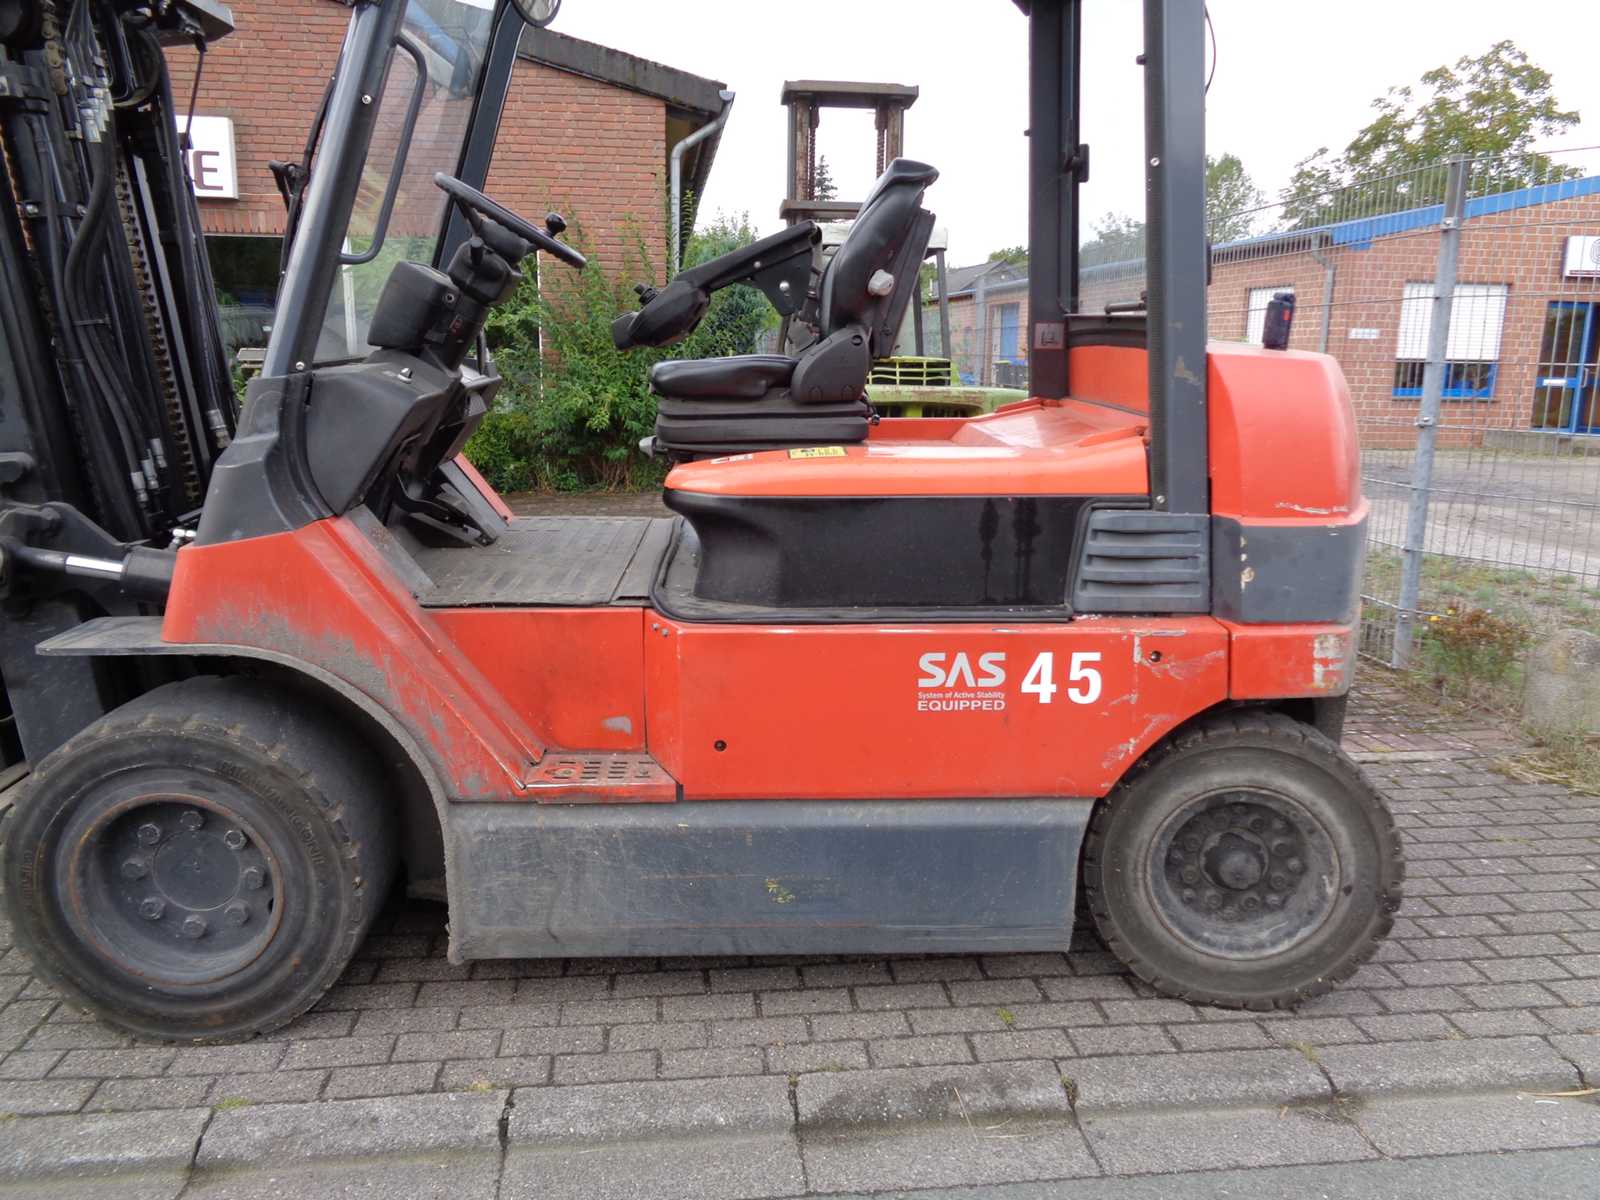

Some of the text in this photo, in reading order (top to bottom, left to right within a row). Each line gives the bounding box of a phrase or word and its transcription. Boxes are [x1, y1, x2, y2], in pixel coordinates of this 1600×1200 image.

[918, 652, 1006, 688] SAS
[1020, 652, 1103, 704] 45
[917, 691, 944, 700] System
[953, 691, 976, 699] Active
[976, 691, 1006, 700] Stability
[917, 700, 1006, 711] EQUIPPED
